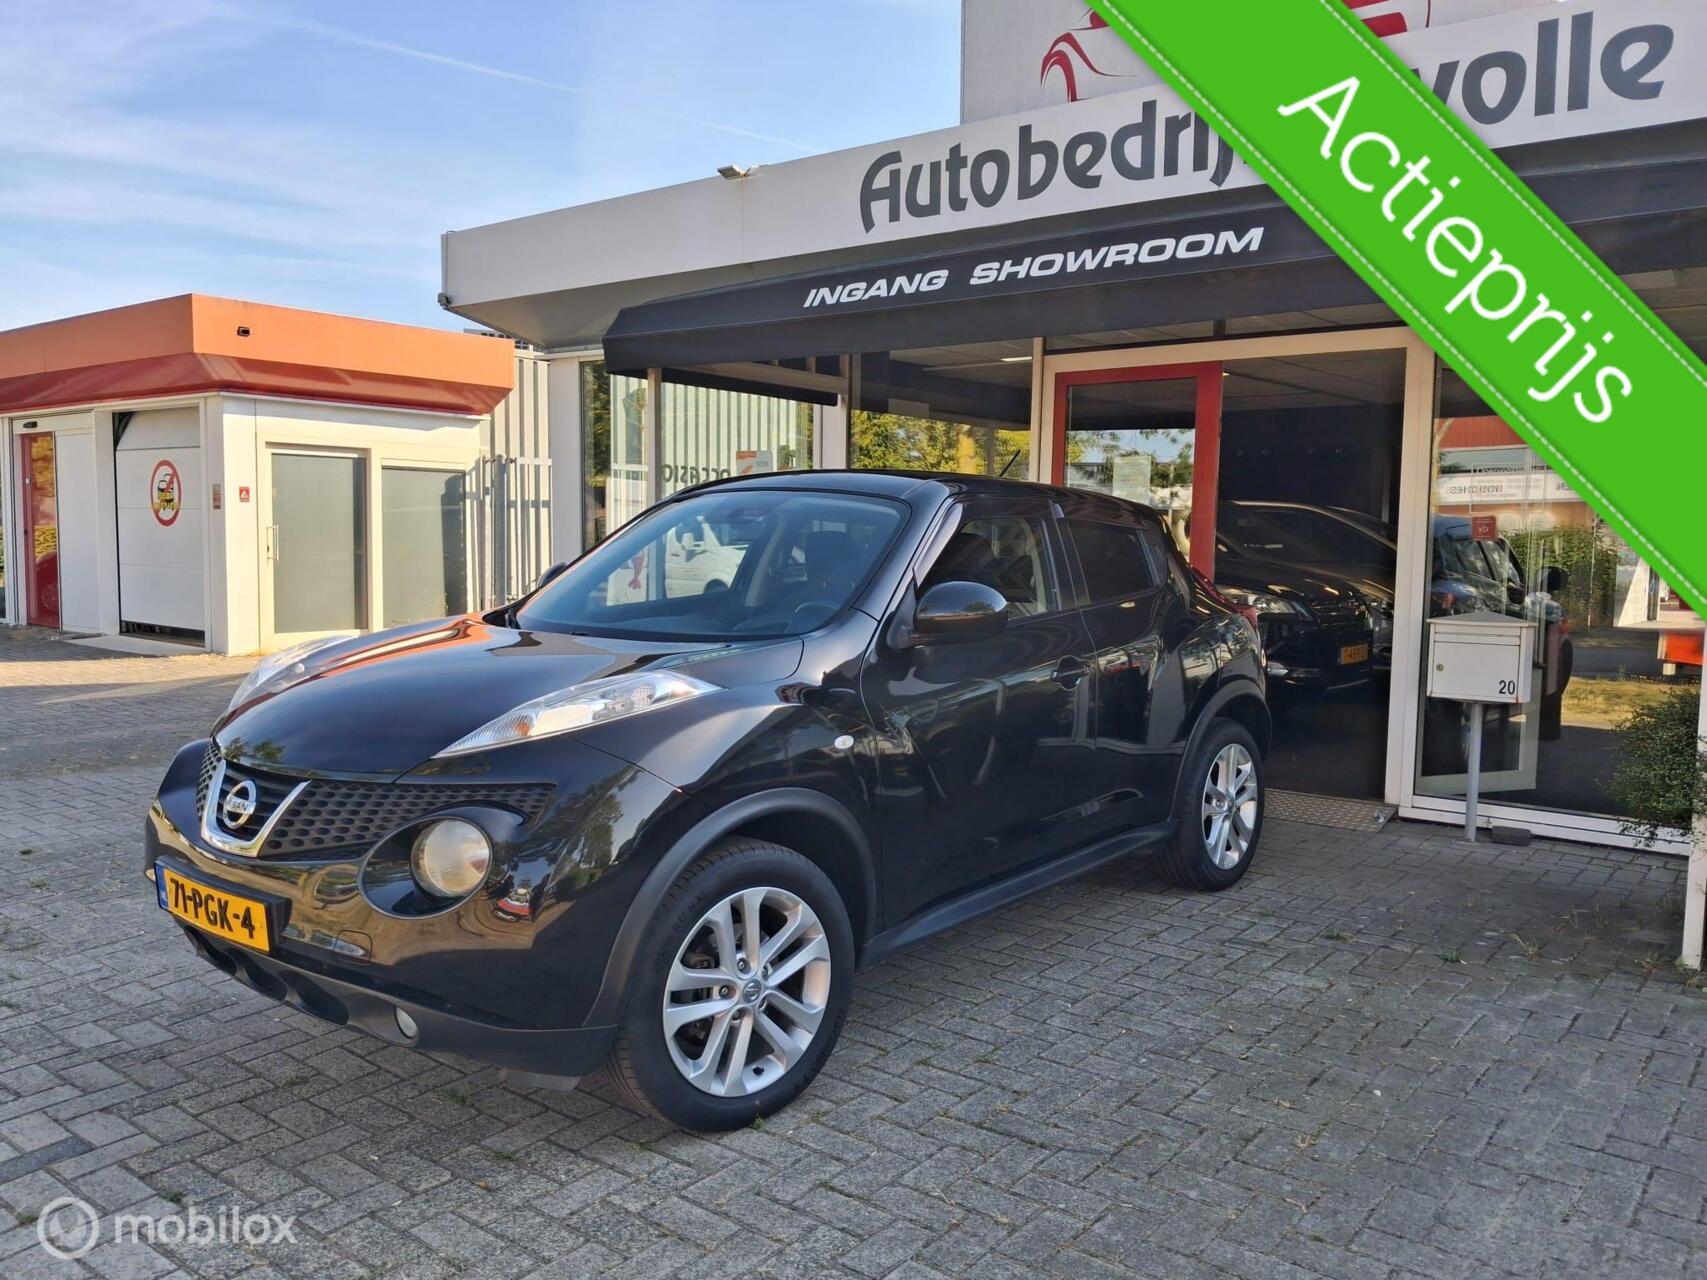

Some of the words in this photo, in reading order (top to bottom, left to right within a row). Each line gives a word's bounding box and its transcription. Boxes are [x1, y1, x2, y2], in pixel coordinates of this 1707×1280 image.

[859, 99, 1247, 234] Autobedrij
[803, 269, 949, 307] INGANG
[969, 227, 1264, 286] SHOWROOM
[1498, 680, 1516, 695] 20
[169, 876, 255, 940] 71-PGK-4
